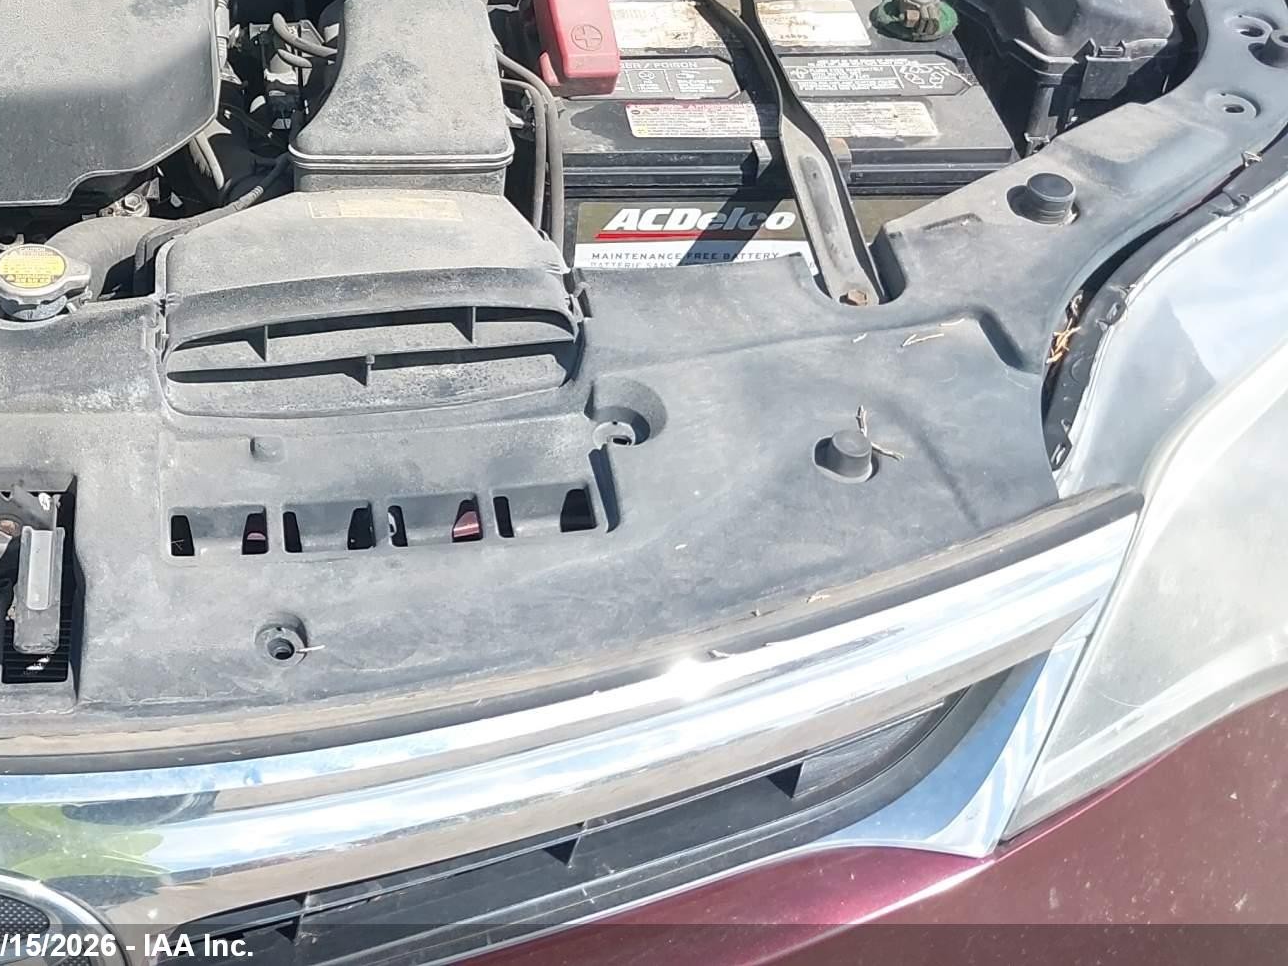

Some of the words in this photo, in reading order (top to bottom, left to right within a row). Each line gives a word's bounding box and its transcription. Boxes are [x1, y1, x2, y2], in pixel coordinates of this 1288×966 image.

[603, 207, 797, 231] ACDelco
[591, 252, 682, 260] MAINTENANCE
[685, 252, 718, 260] FREE
[723, 252, 779, 260] BATTERY
